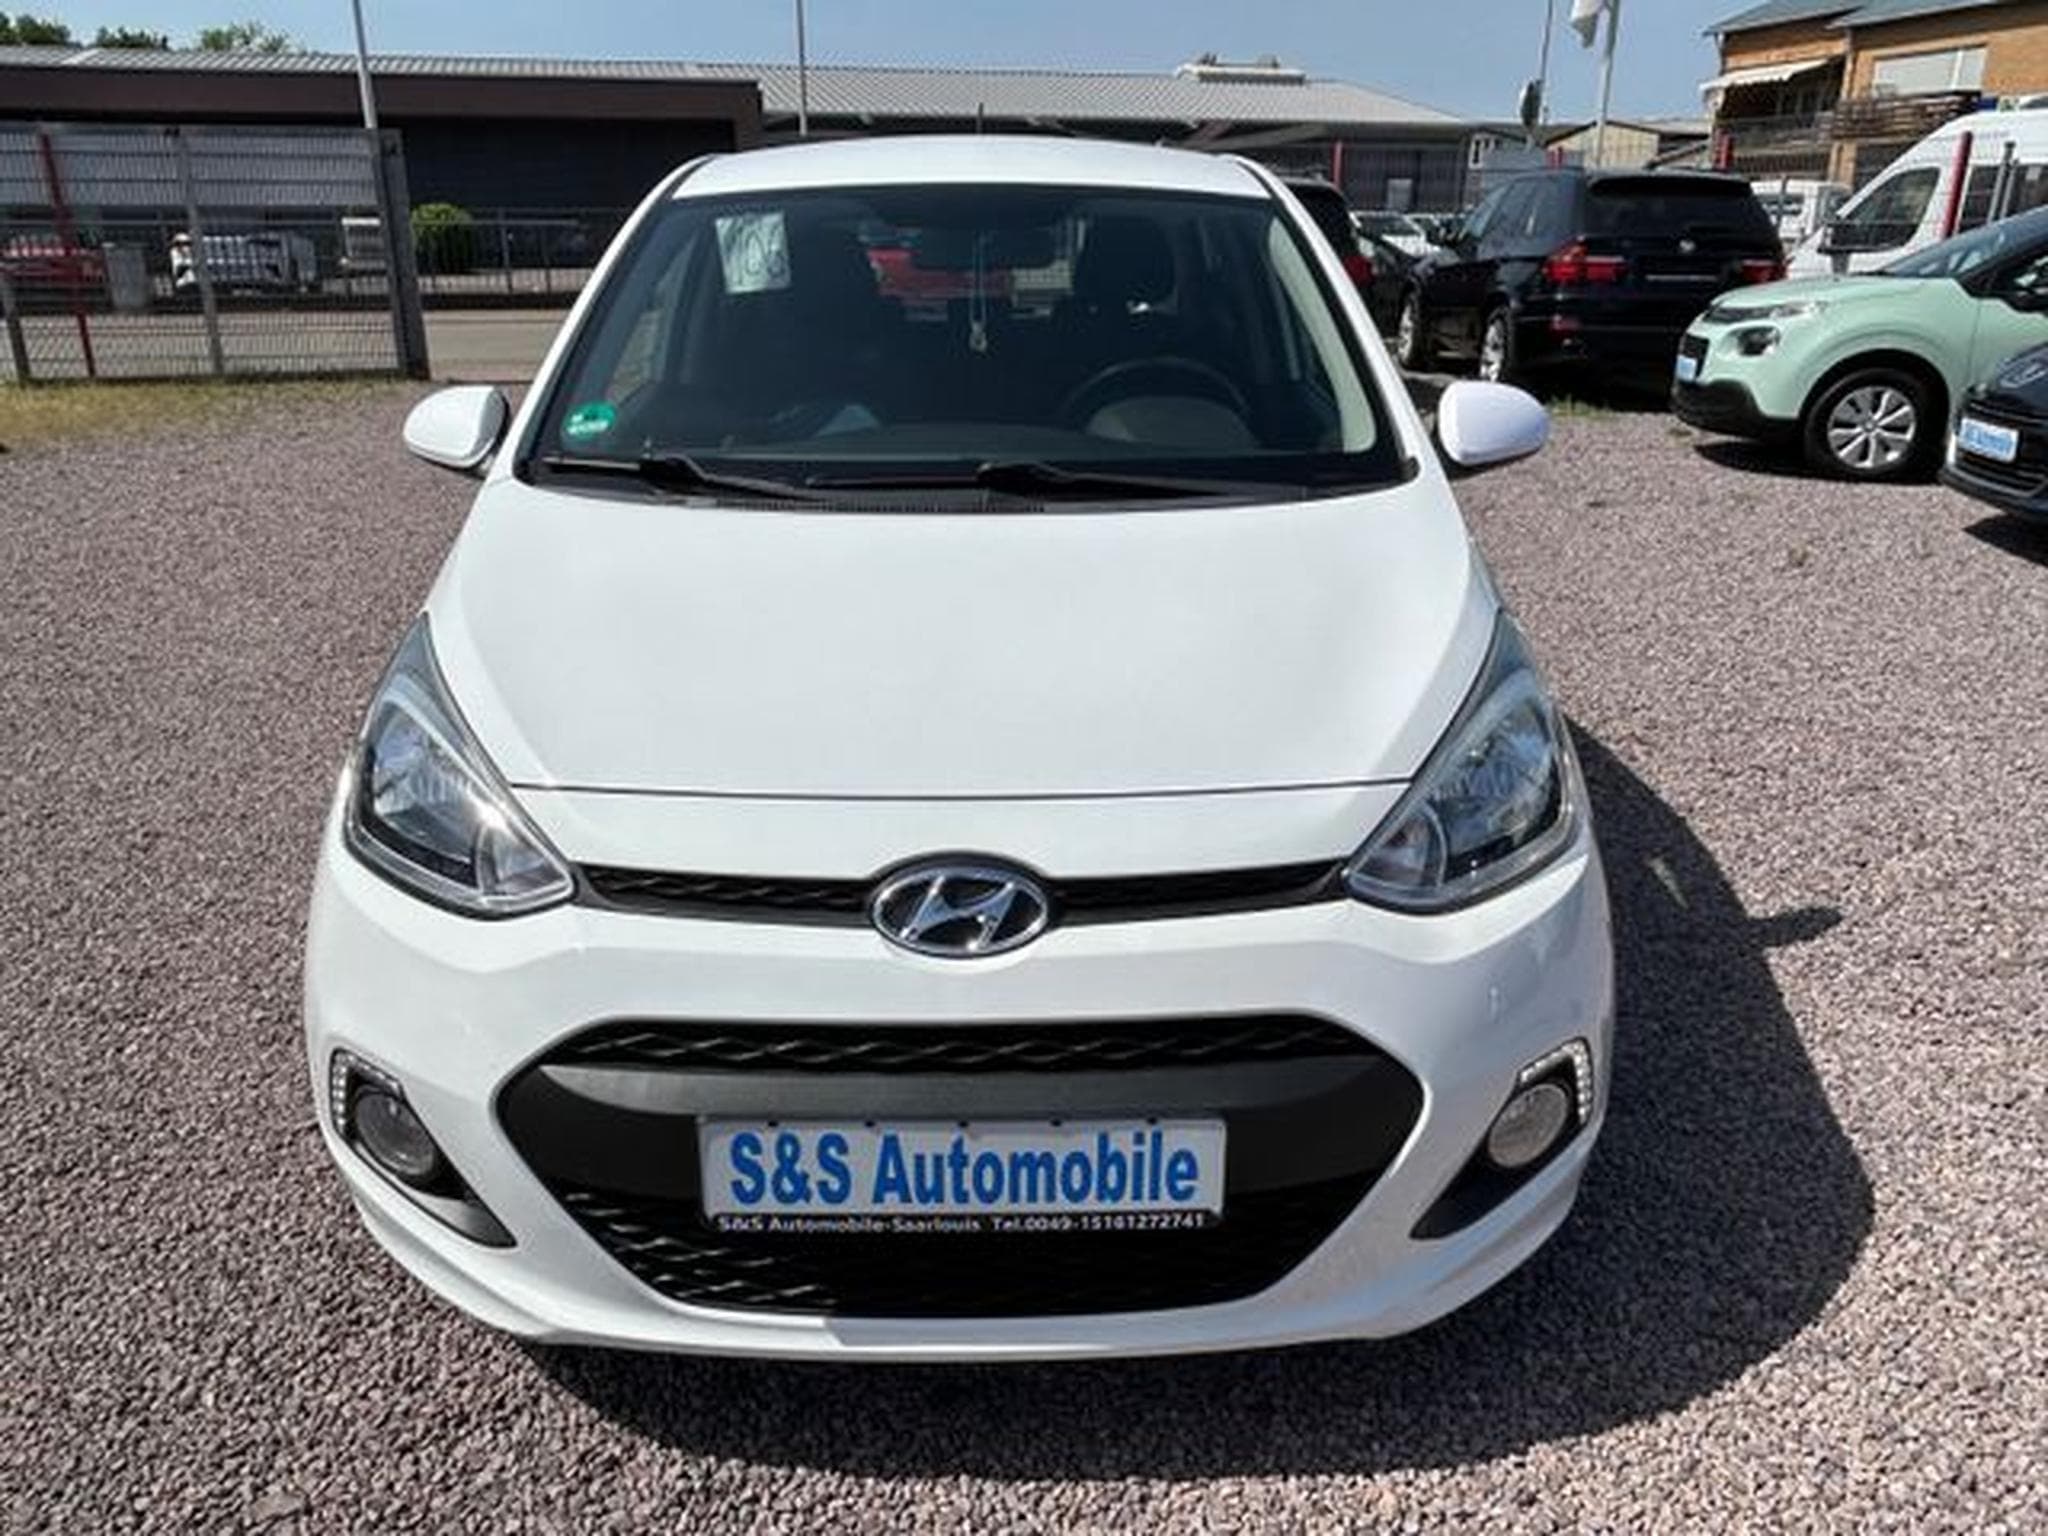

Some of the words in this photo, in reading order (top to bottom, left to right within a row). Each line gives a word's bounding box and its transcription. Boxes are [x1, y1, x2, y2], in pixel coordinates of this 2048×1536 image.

[730, 1131, 853, 1207] S&S
[872, 1130, 1200, 1206] Automobile
[718, 1215, 764, 1232] S&S
